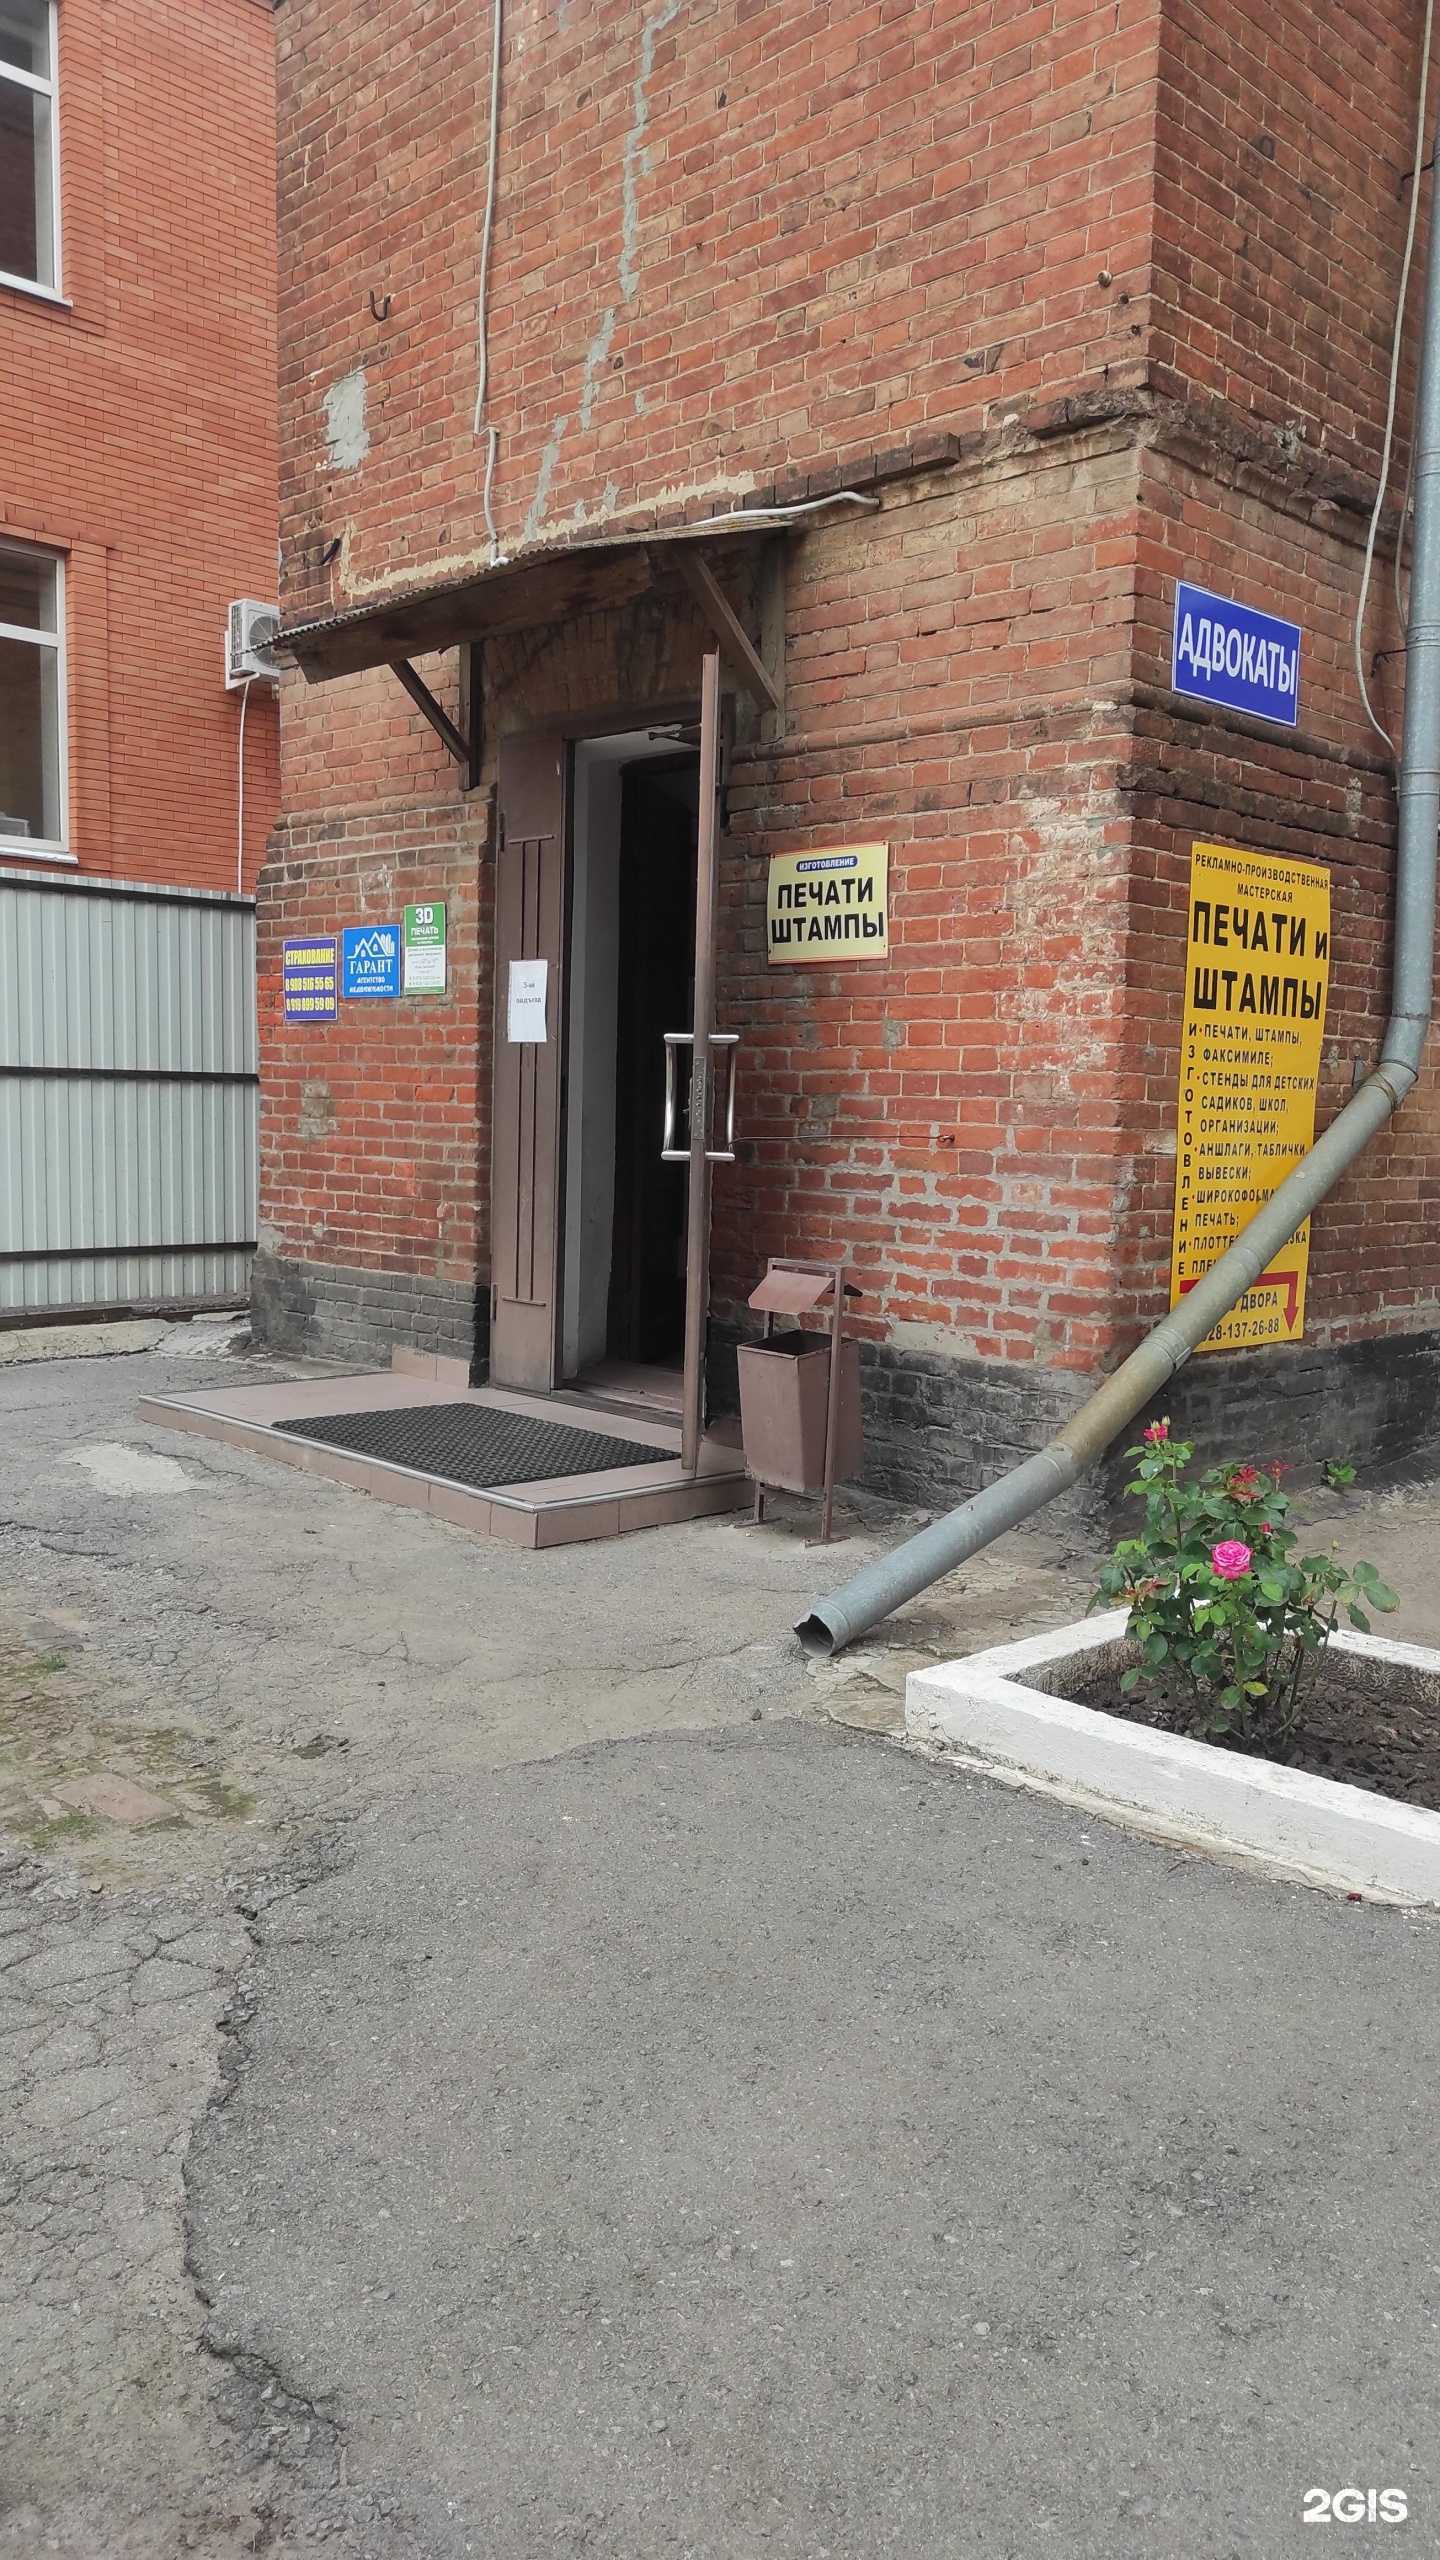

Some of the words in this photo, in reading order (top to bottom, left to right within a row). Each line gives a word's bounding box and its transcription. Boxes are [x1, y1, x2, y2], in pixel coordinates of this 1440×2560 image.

[1178, 613, 1296, 696] АДВОКАТЫ
[799, 857, 855, 871] ИЗГОТОВЛЕНИЕ
[1195, 853, 1330, 889] РЕКЛАМНО-ПРОИЗВОДСТВЕННАЯ
[777, 877, 873, 909] ПЕЧАТИ
[1237, 883, 1293, 903] МАСТЕРСКАЯ
[415, 907, 433, 925] 3D
[411, 927, 439, 937] ПЕЧАТЬ
[771, 911, 884, 943] ШТАМПЫ
[1192, 901, 1306, 956] ПЕЧАТИ
[285, 948, 335, 966] СТРАХОВАНИЕ
[350, 959, 393, 975] ГАРАНТ
[1193, 967, 1322, 1020] ШТАМПЫ
[1204, 1023, 1251, 1042] ПЕЧАТИ,
[1255, 1027, 1302, 1047] ШТАМПЫ,
[1202, 1047, 1273, 1068] ФАКСИМИЛЕ;
[1202, 1071, 1248, 1089] СТЕНДЫ
[1251, 1074, 1272, 1090] ДЛЯ
[1274, 1075, 1314, 1091] ДЕТСКИХ
[1201, 1096, 1255, 1113] САДИКОВ,
[1200, 1119, 1279, 1136] ОРГАНИЗАЦИИ;
[1200, 1143, 1254, 1158] АНШЛАГИ,
[1198, 1166, 1251, 1180] ВЫВЕСКИ;
[1195, 1213, 1239, 1228] ПЕЧАТЬ;
[1241, 1291, 1278, 1313] ДВОРА
